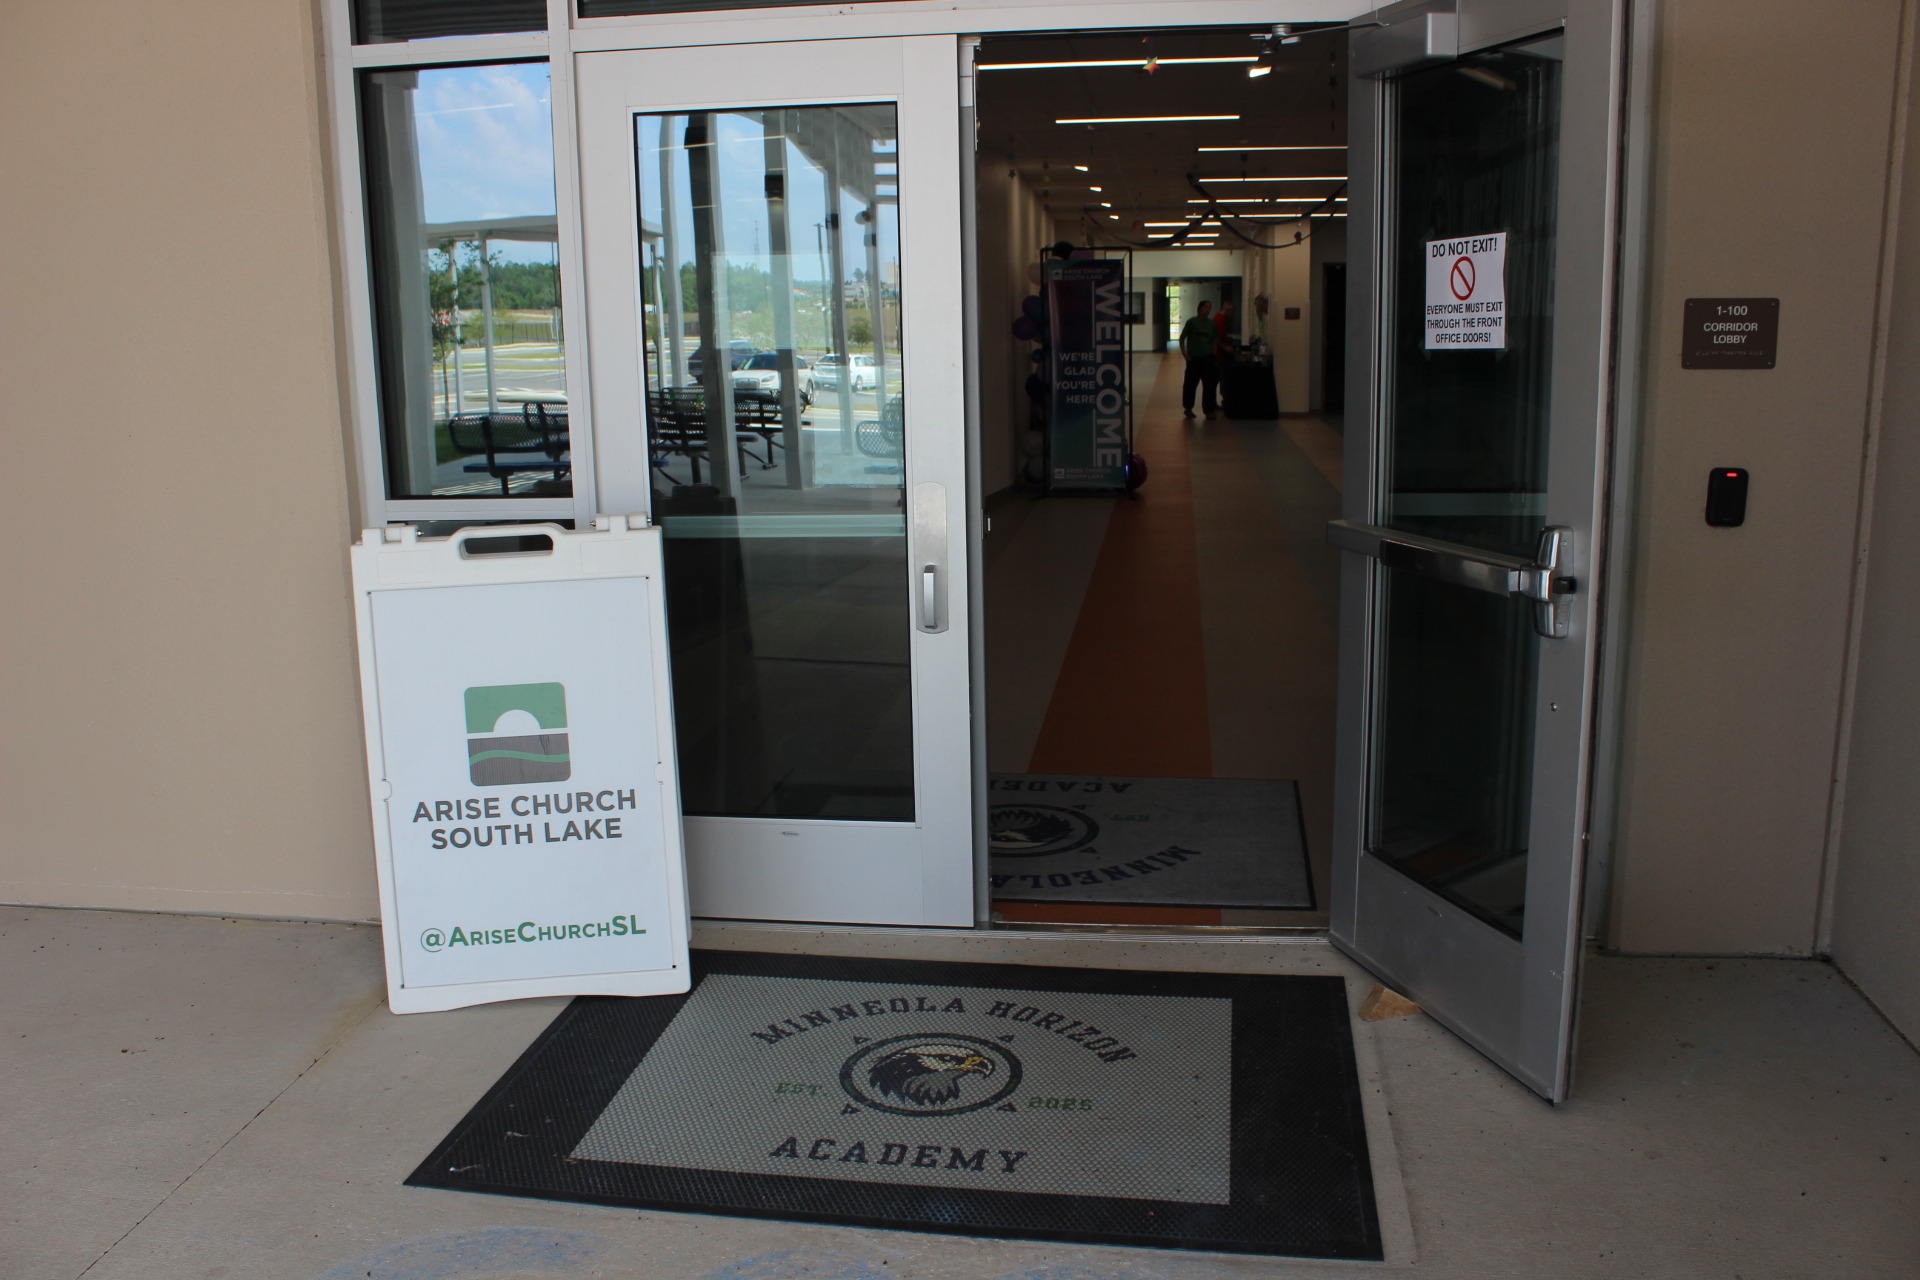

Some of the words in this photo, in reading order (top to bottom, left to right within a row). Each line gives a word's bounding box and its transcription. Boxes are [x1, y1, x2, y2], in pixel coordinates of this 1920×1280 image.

[1432, 244, 1446, 258] DO
[1448, 240, 1470, 256] NOT
[1472, 237, 1497, 254] EXIT!
[1426, 304, 1464, 315] EVERYONE
[1465, 302, 1484, 313] MUST
[1486, 301, 1503, 312] EXIT
[1716, 305, 1748, 316] 1-100
[1426, 318, 1460, 329] THROUGH
[1462, 318, 1476, 328] THE
[1477, 316, 1503, 328] FRONT
[1703, 322, 1758, 332] CORRIDOR
[1436, 333, 1461, 344] OFFICE
[1463, 332, 1491, 343] DOORS!
[1713, 334, 1748, 344] LOBBY
[1058, 352, 1095, 362] WE'RE
[1064, 366, 1095, 376] GLAD
[1095, 280, 1122, 467] WELCOME
[1055, 381, 1095, 390] YOU'RE
[1066, 394, 1096, 404] HERE
[412, 797, 501, 823] ARISE
[511, 788, 637, 817] CHURCH
[431, 823, 534, 850] SOUTH
[544, 817, 623, 843] LAKE
[750, 996, 965, 1045] MINNEOLA
[985, 999, 1137, 1064] HORIZON
[1028, 1096, 1093, 1111] 2025
[768, 1135, 1028, 1175] ACADEMY
